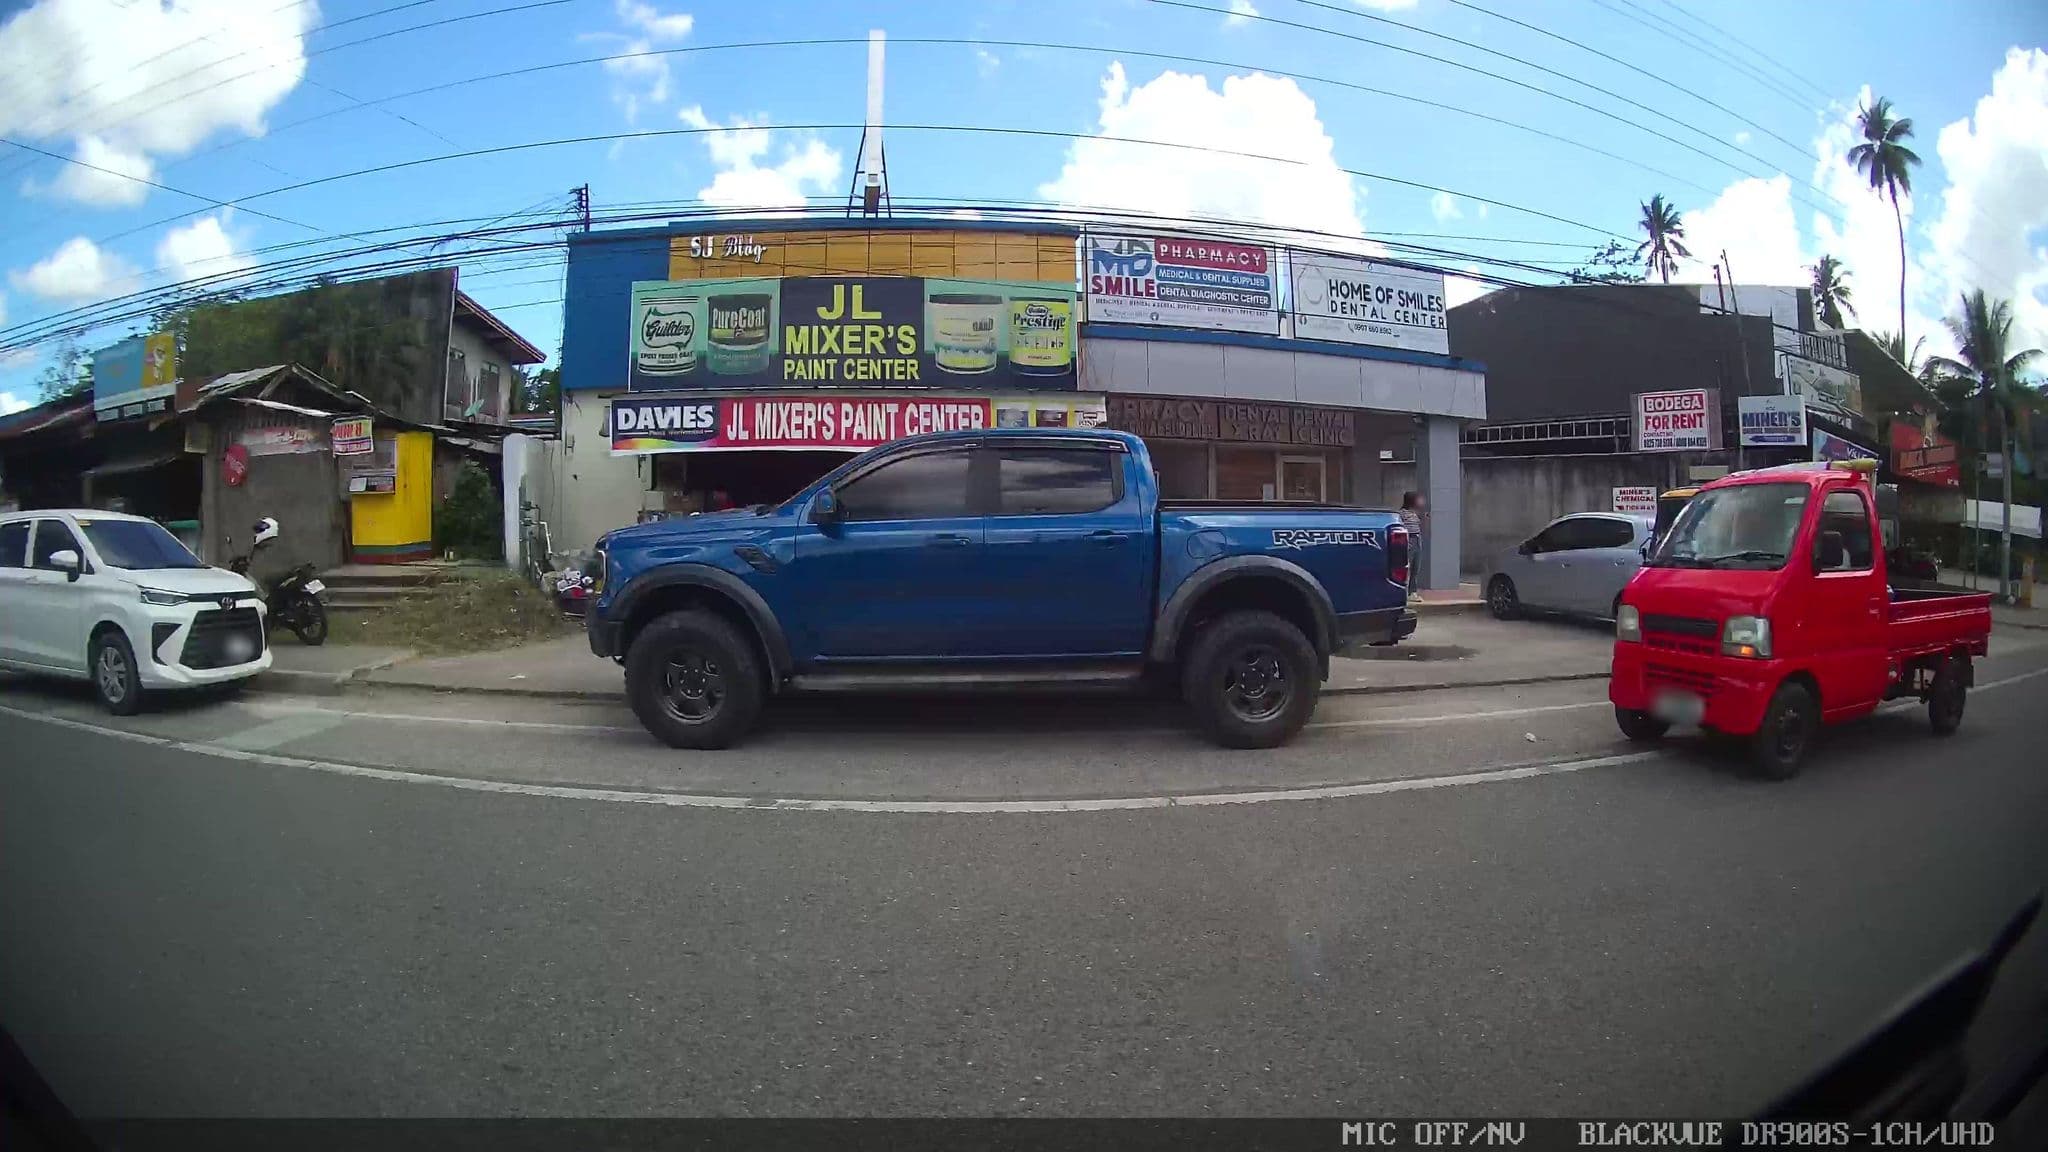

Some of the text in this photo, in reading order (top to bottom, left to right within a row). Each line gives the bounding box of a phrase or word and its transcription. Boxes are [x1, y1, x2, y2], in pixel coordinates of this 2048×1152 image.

[691, 236, 713, 257] SJ
[1160, 244, 1261, 266] PHARMACY
[1092, 276, 1155, 298] SMILE
[1159, 269, 1193, 280] MEDICAL
[1202, 273, 1231, 283] DENTAL
[1232, 276, 1265, 287] SUPPLIES
[816, 284, 882, 320] JL
[1160, 287, 1268, 305] DENTAL DIAGNOSTIC CENTER
[1329, 279, 1443, 313] HOME OF SMILES
[712, 307, 766, 329] PureCoat
[1330, 301, 1445, 328] DENTAL CENTER
[785, 325, 917, 355] MIXER'S
[783, 358, 920, 380] PAINT CENTER
[1645, 395, 1702, 411] BODEGA
[617, 405, 714, 430] DAVIES
[727, 402, 984, 441] JL MIXER'S PAINT CENTER
[1645, 413, 1705, 430] FOR RENT
[1270, 530, 1382, 550] RAPTOR
